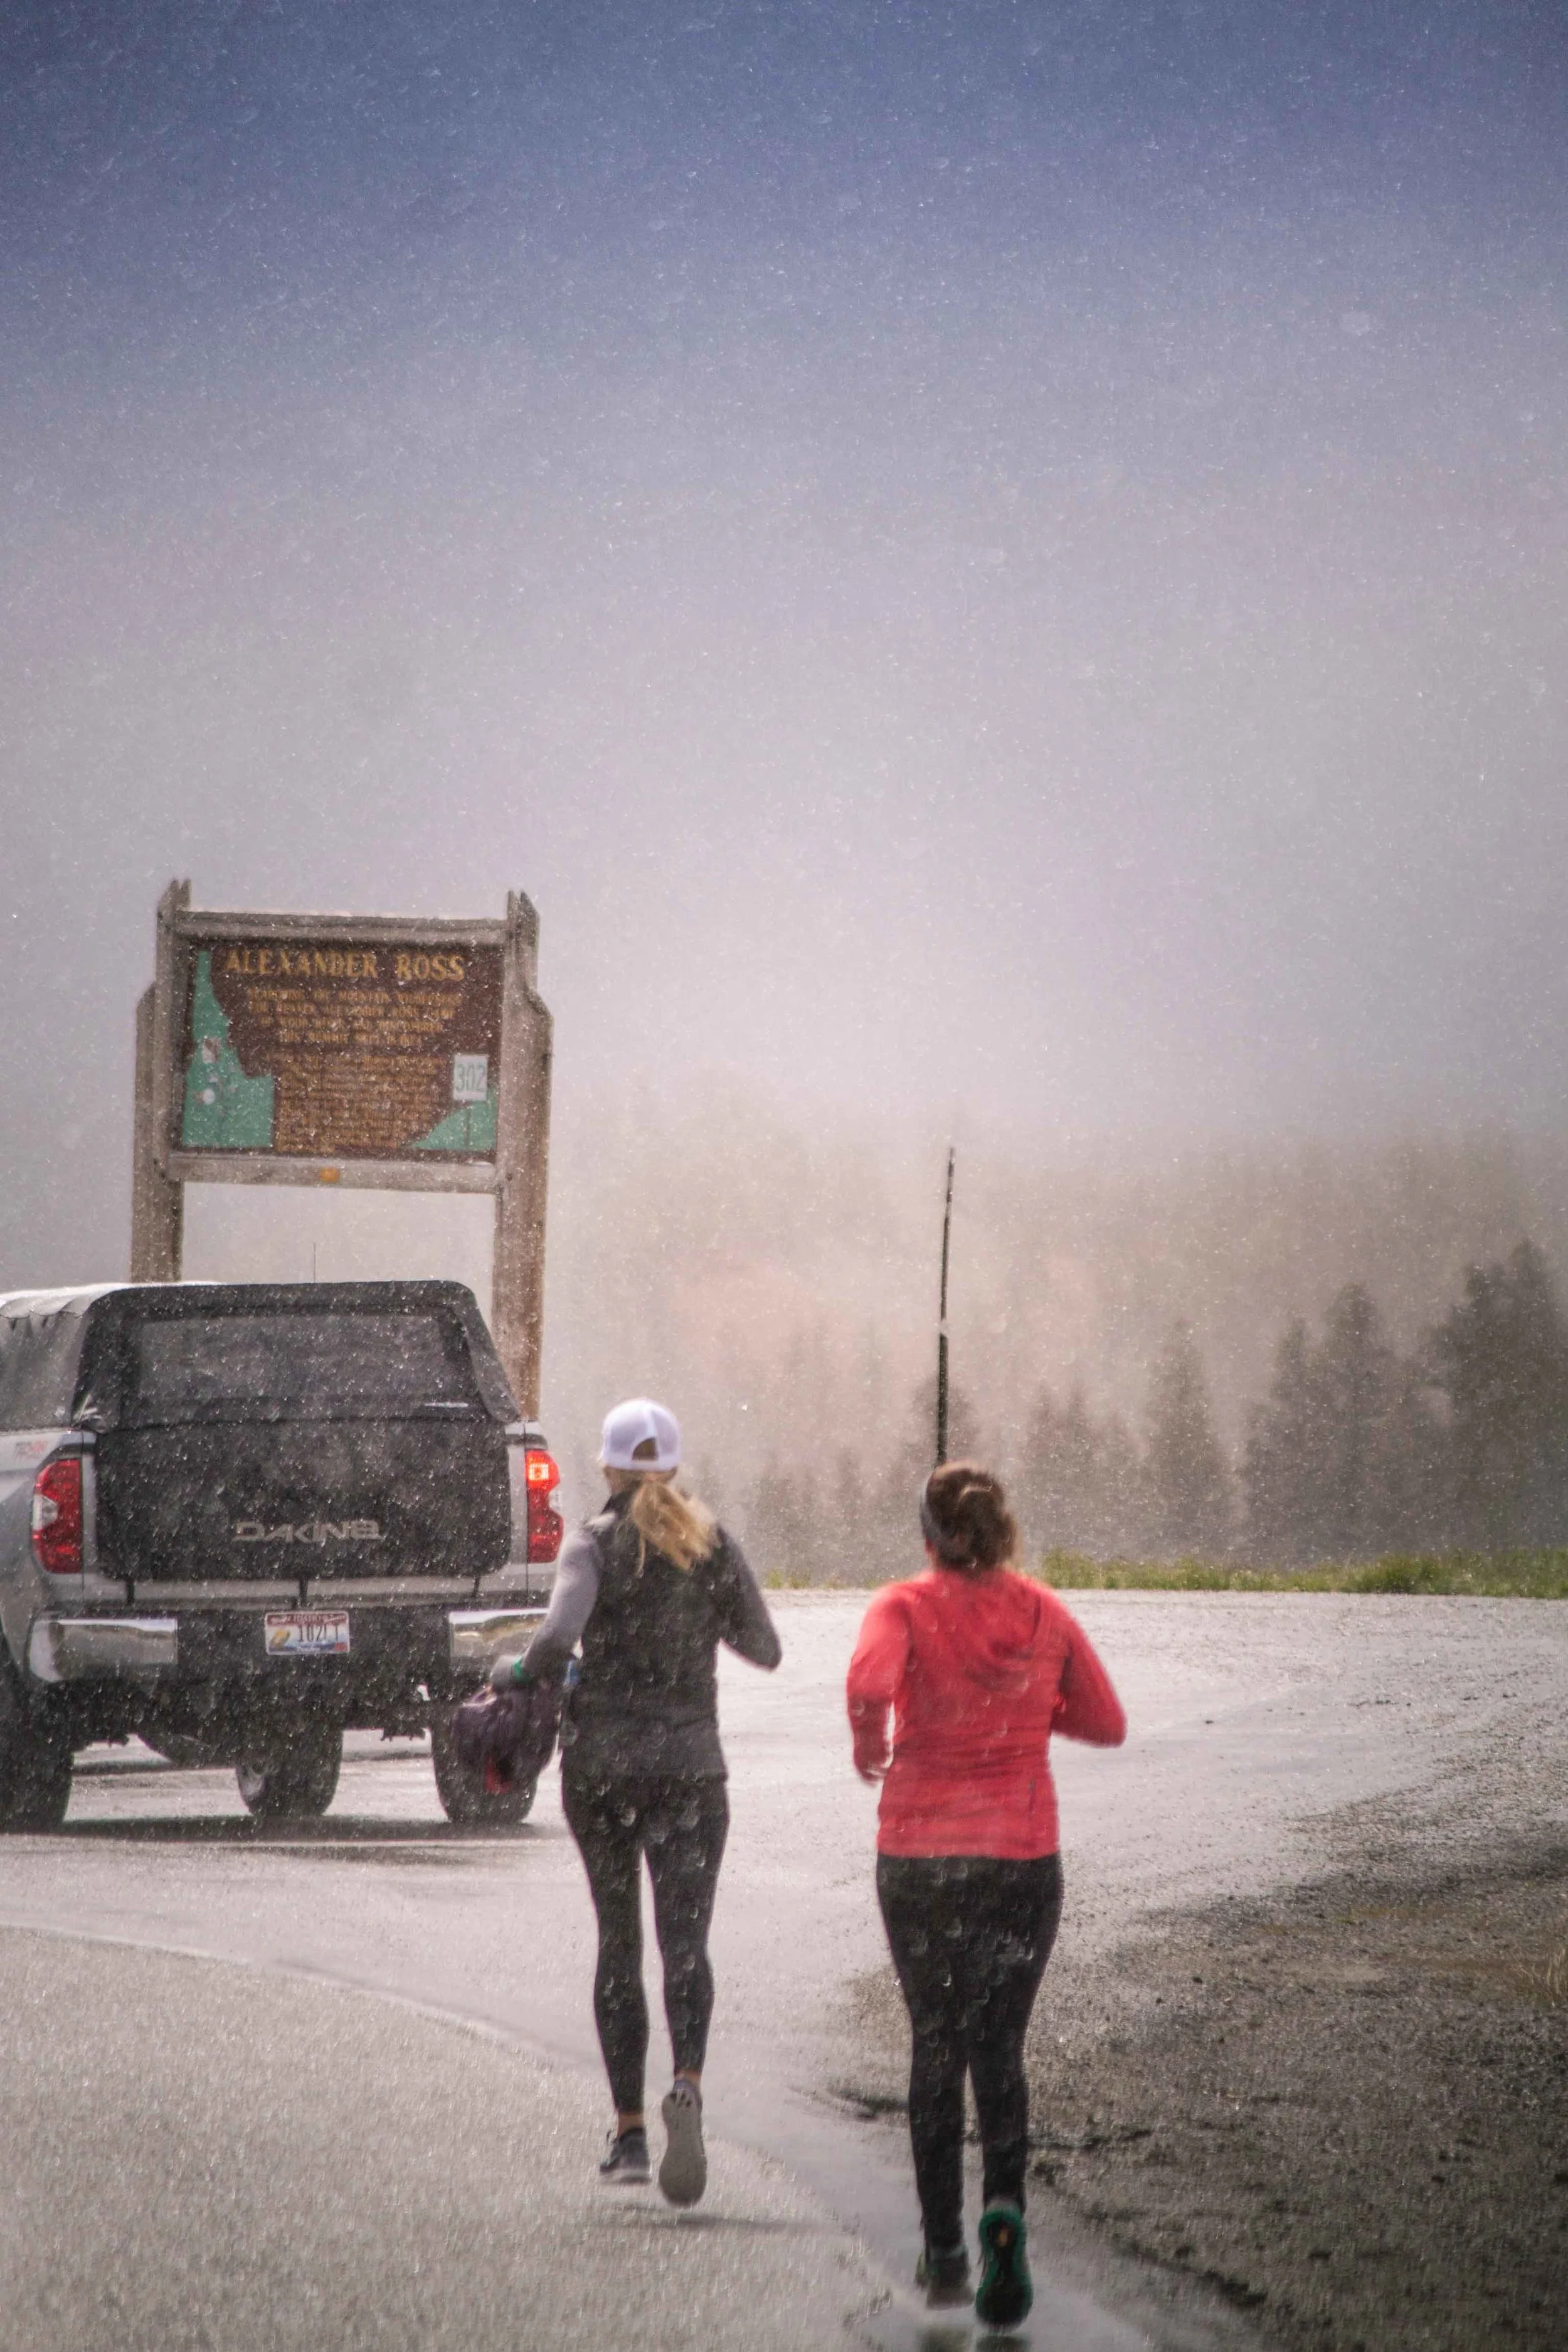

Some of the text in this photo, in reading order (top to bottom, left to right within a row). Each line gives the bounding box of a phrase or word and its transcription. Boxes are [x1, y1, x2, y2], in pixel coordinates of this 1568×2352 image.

[225, 948, 466, 981] ALEXANDER ROSS
[455, 1062, 485, 1091] 302
[232, 1520, 386, 1543] DAKINE
